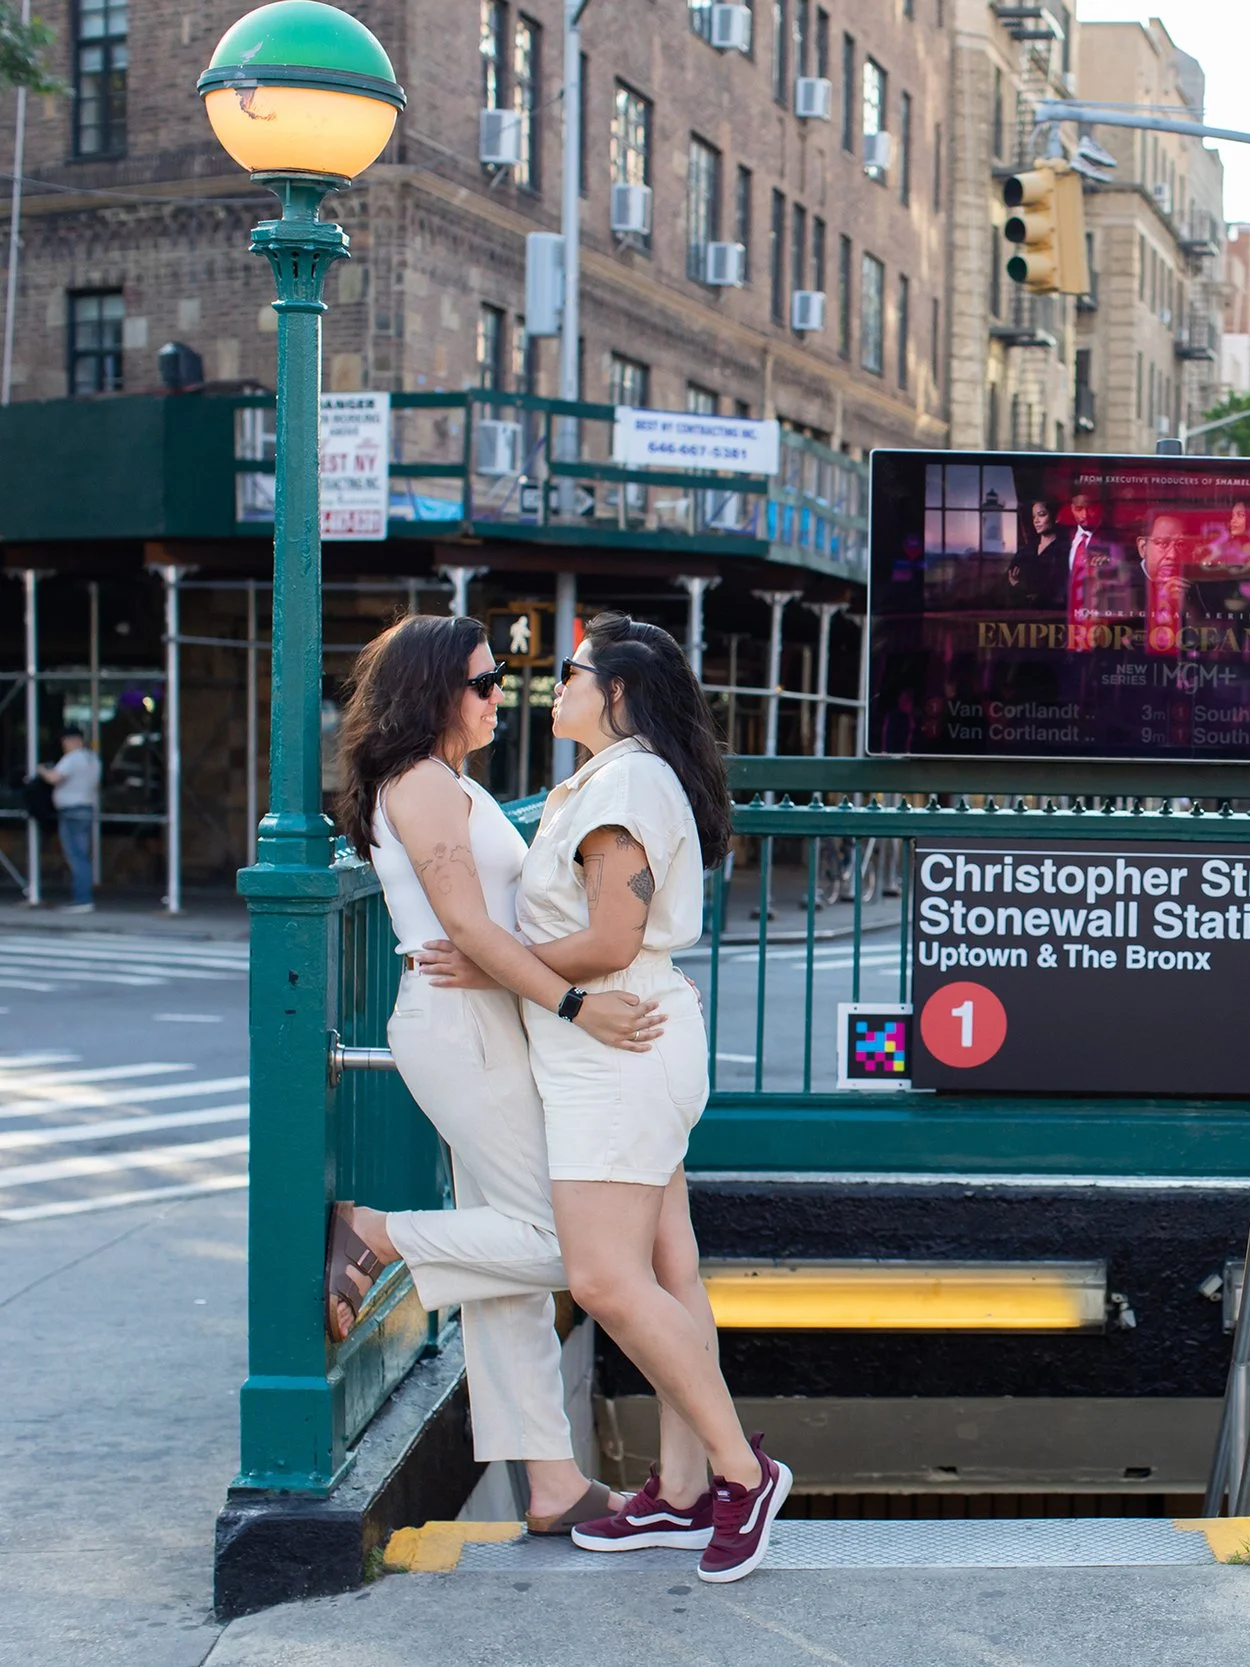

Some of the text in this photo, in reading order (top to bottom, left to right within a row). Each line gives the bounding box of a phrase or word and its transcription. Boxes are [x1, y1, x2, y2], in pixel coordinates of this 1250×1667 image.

[321, 453, 348, 473] EST
[1079, 475, 1102, 483] FROM
[1105, 476, 1148, 484] EXECUTIVE
[1151, 477, 1198, 485] PRODUCERS
[1105, 610, 1191, 619] ORIGINAL
[977, 622, 1134, 651] EMPEROR
[1101, 674, 1147, 685] SERIES
[1116, 662, 1236, 695] NEW MGM+
[947, 701, 983, 718] Van
[989, 702, 1080, 720] Cortlandt
[1141, 705, 1166, 721] 3m
[1194, 705, 1250, 723] South
[947, 723, 983, 739] Van
[989, 725, 1079, 742] Cortlandt
[1141, 727, 1166, 743] 9m
[1193, 728, 1250, 745] South
[920, 853, 1188, 904] Christopher
[919, 897, 1138, 938] Stonewall
[918, 941, 1212, 972] Uptown & The Bronx
[951, 1000, 973, 1048] 1
